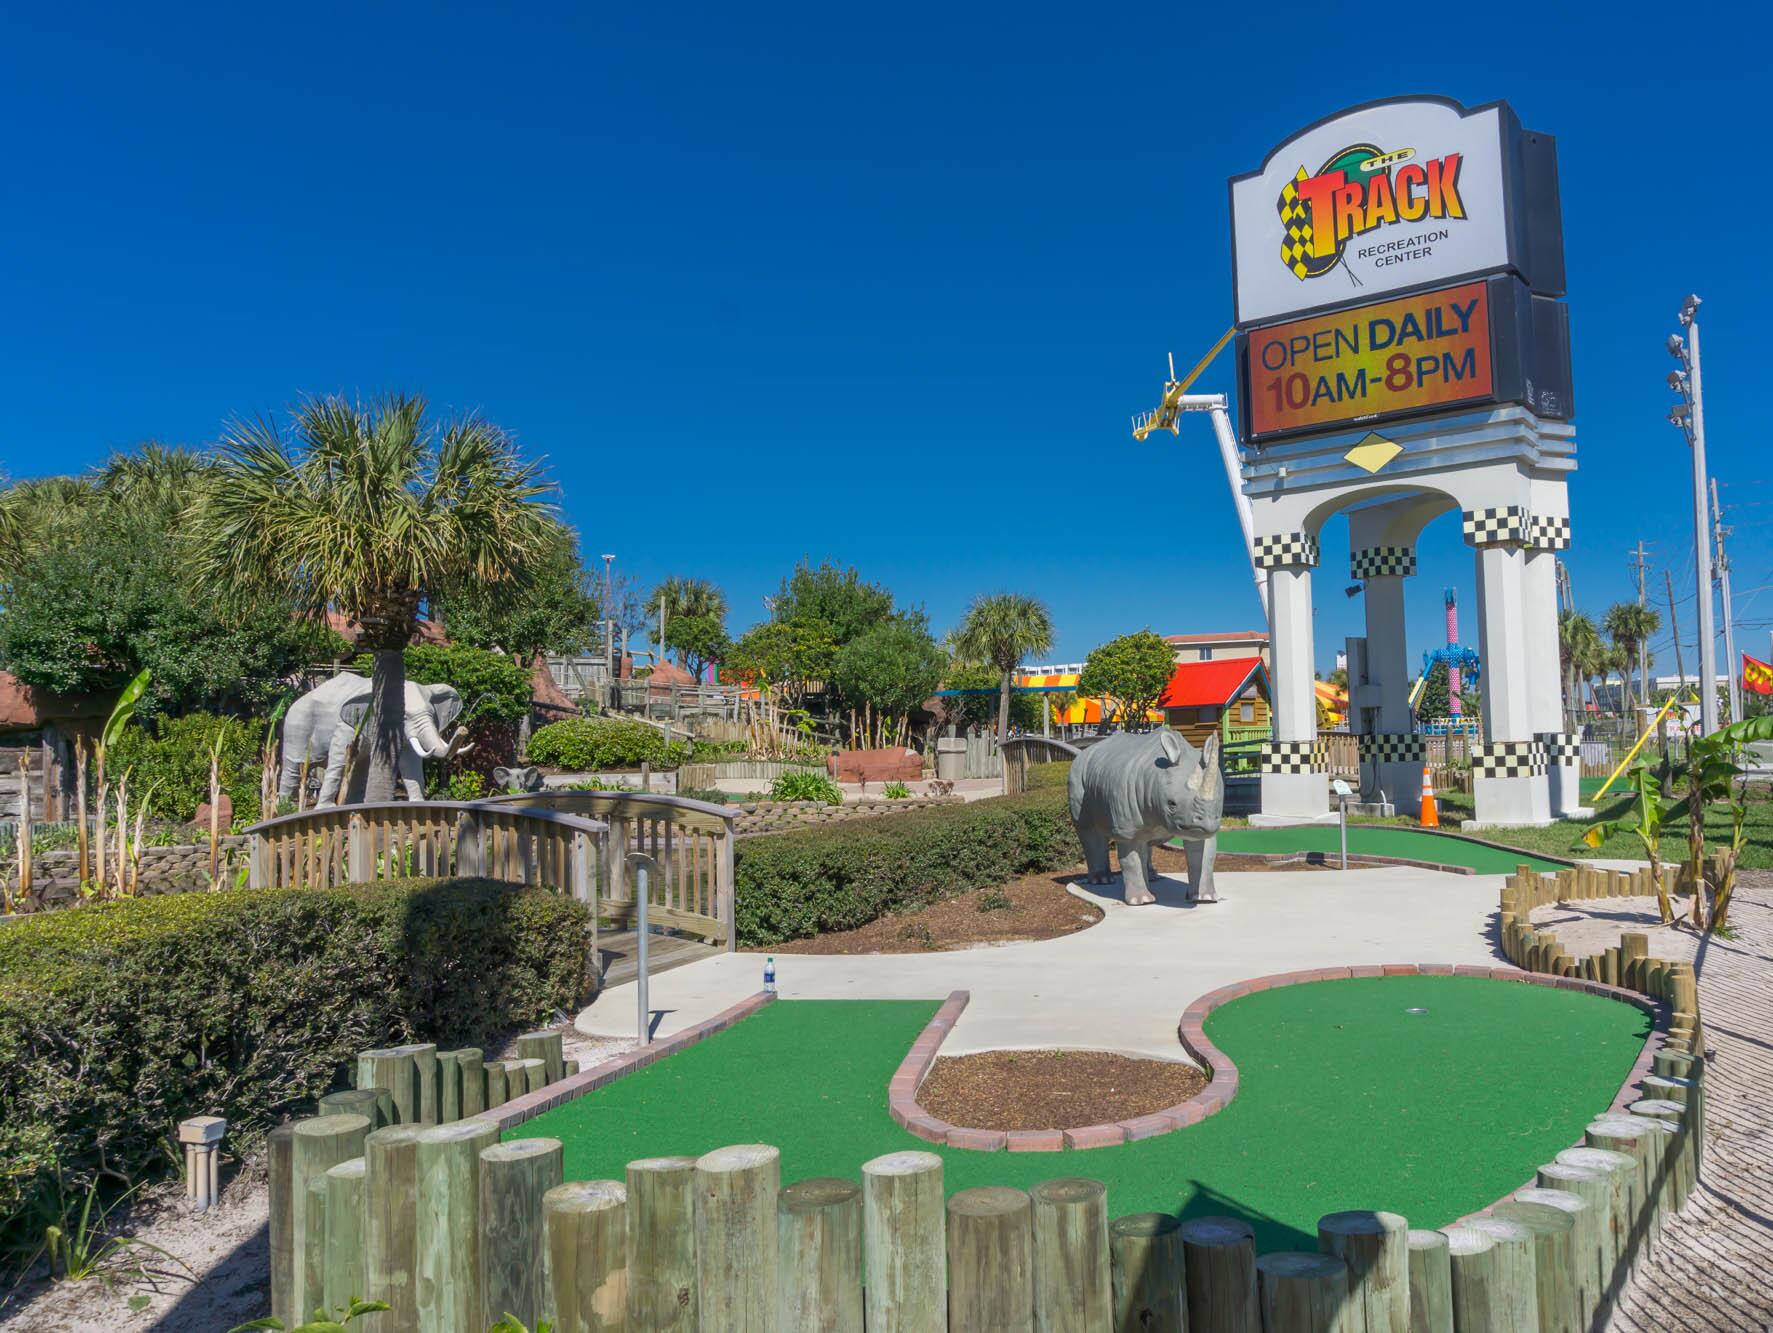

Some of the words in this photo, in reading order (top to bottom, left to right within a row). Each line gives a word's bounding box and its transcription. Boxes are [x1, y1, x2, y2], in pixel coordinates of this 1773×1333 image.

[1366, 151, 1409, 168] THE
[1298, 152, 1467, 259] TRACK
[1358, 229, 1449, 259] RECREATION
[1375, 246, 1432, 268] CENTER
[1262, 324, 1359, 371] OPEN
[1369, 299, 1478, 352] DAILY
[1266, 347, 1477, 412] 10AM-8PM
